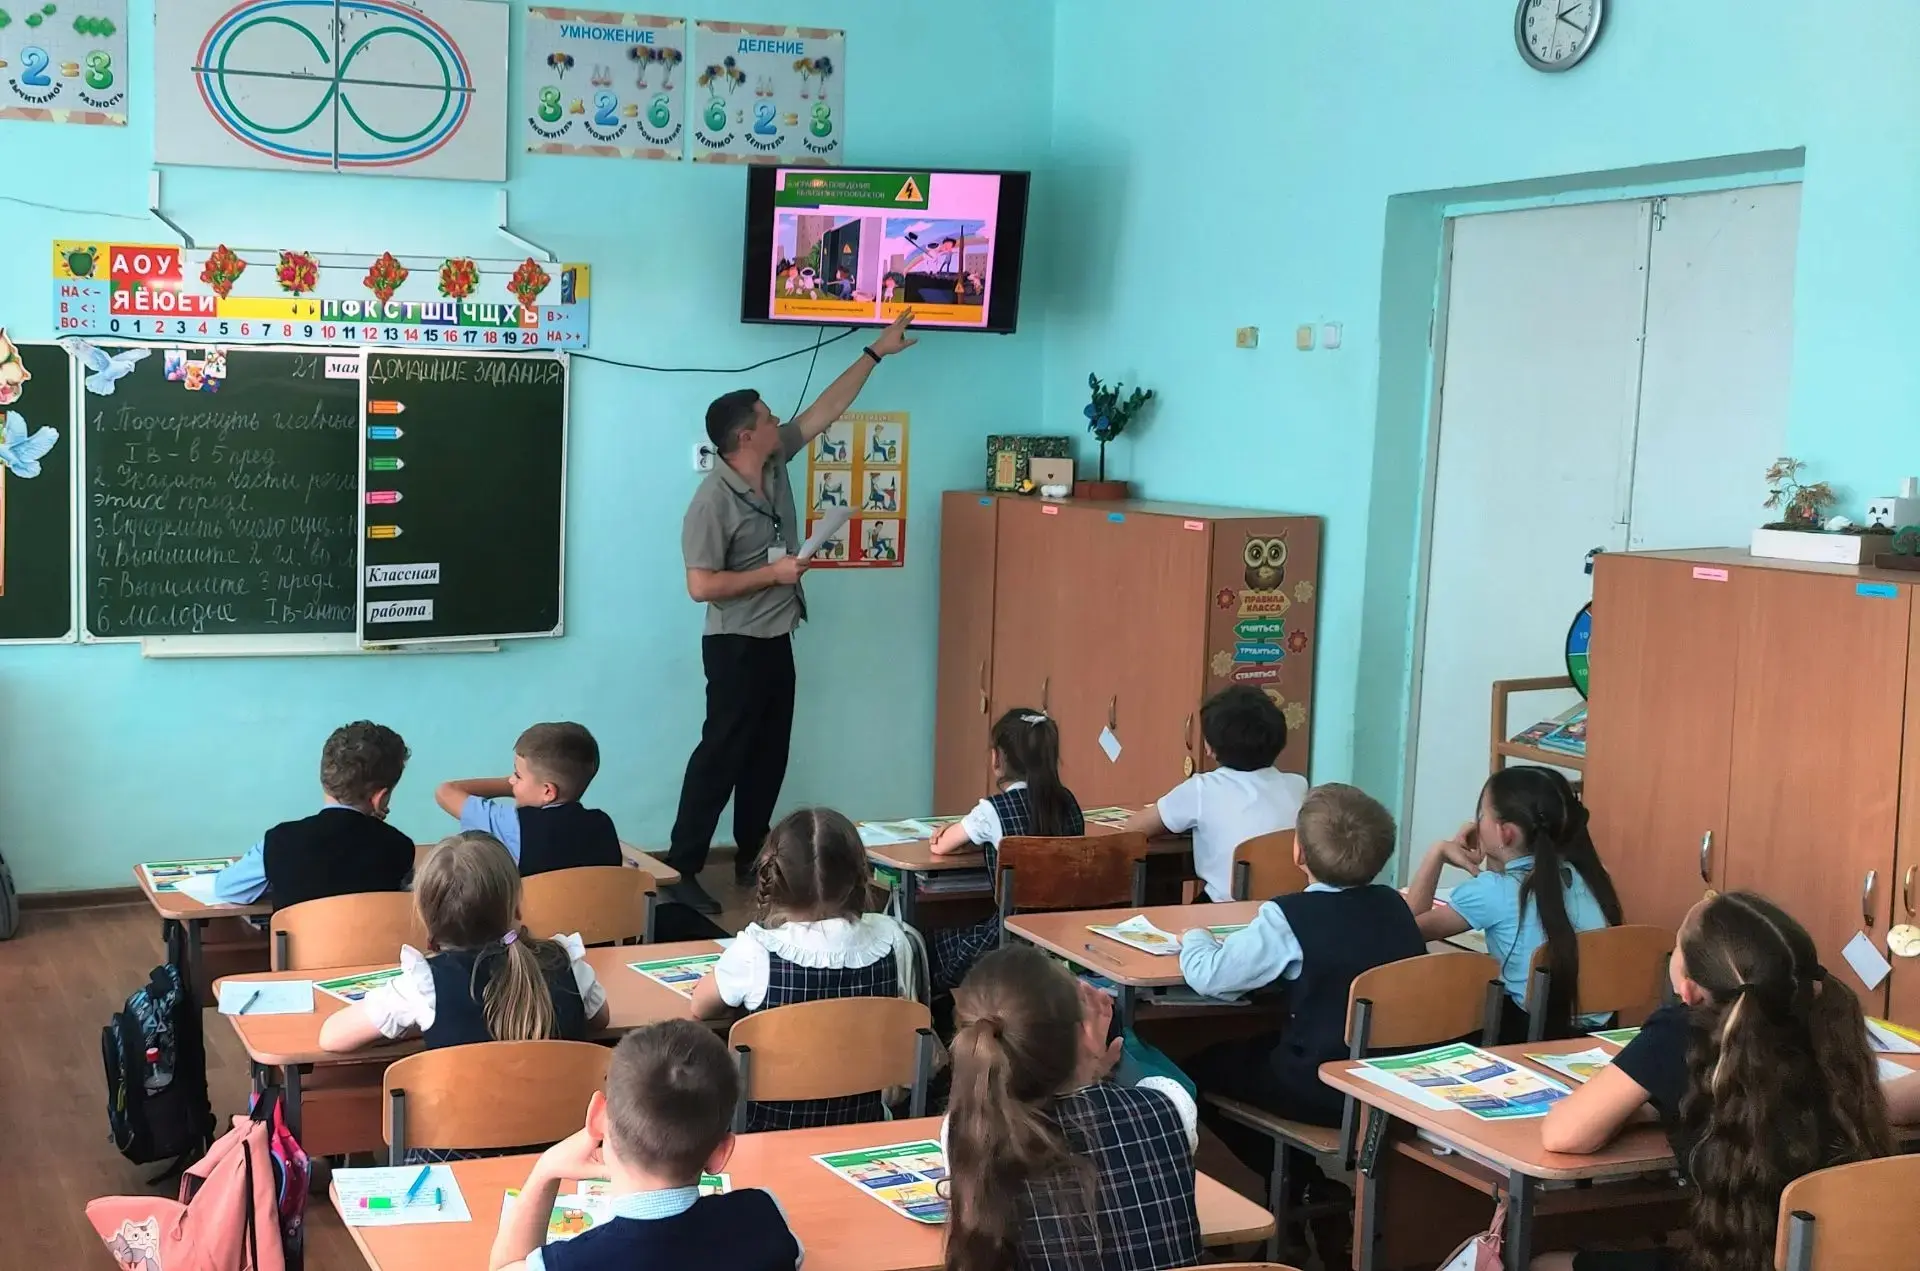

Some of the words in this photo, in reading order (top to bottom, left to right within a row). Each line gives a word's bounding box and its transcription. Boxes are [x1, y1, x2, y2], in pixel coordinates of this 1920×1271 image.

[1528, 16, 1535, 27] 9
[560, 24, 655, 44] УМНОЖЕНИЕ
[1531, 34, 1538, 45] 8
[737, 38, 804, 55] ДЕЛЕНИЕ
[1541, 46, 1547, 57] 7
[1555, 49, 1562, 60] 6
[1570, 42, 1576, 53] 5
[20, 46, 51, 86] 2
[85, 50, 114, 89] 3
[9, 79, 63, 104] ВЫЧИТАЕМОЕ
[79, 91, 124, 108] РАЗНОСТЬ
[538, 85, 563, 122] 3
[593, 89, 619, 126] 2
[647, 92, 670, 128] 6
[703, 96, 727, 132] 6
[753, 101, 777, 134] 2
[809, 102, 832, 137] 3
[528, 117, 573, 139] МНОЖИТЕЛЬ
[584, 121, 628, 142] МНОЖИТЕЛЬ
[695, 131, 735, 149] ДЕЛИМОЕ
[744, 132, 785, 151] ДЕЛИТЕЛЬ
[803, 136, 838, 154] ЧАСТНОЕ
[61, 285, 79, 298] НА
[60, 302, 68, 313] В
[61, 317, 78, 329] ВО
[110, 318, 120, 333] 0
[133, 319, 141, 332] 1
[155, 320, 164, 333] 2
[177, 320, 186, 334] 3
[198, 321, 208, 334] 4
[219, 322, 228, 335] 5
[240, 323, 250, 335] 6
[262, 323, 271, 336] 7
[283, 324, 292, 337] 8
[304, 325, 313, 338] 9
[321, 325, 336, 338] 10
[342, 326, 356, 339] 11
[362, 327, 378, 340] 12
[384, 328, 398, 340] 13
[404, 328, 419, 341] 14
[424, 329, 438, 342] 15
[443, 329, 458, 342] 16
[463, 330, 478, 343] 17
[483, 331, 498, 344] 18
[502, 331, 517, 344] 19
[522, 332, 538, 345] 20
[547, 331, 562, 342] НА
[293, 356, 318, 379] 21
[328, 363, 360, 375] мая
[369, 357, 468, 385] ДОМАШНИЕ
[93, 411, 105, 432] 1.
[212, 445, 228, 464] 5
[94, 493, 166, 510] этих
[94, 517, 109, 538] 3.
[97, 543, 109, 567] 4.
[249, 540, 262, 565] 2
[369, 566, 438, 583] Классная
[1244, 595, 1285, 604] ПРАВИЛА
[1246, 604, 1281, 612] КЛАССА
[370, 603, 427, 622] работа
[1240, 624, 1280, 633] УЧИТЬСЯ
[1239, 647, 1281, 656] ТРУДИТЬСЯ
